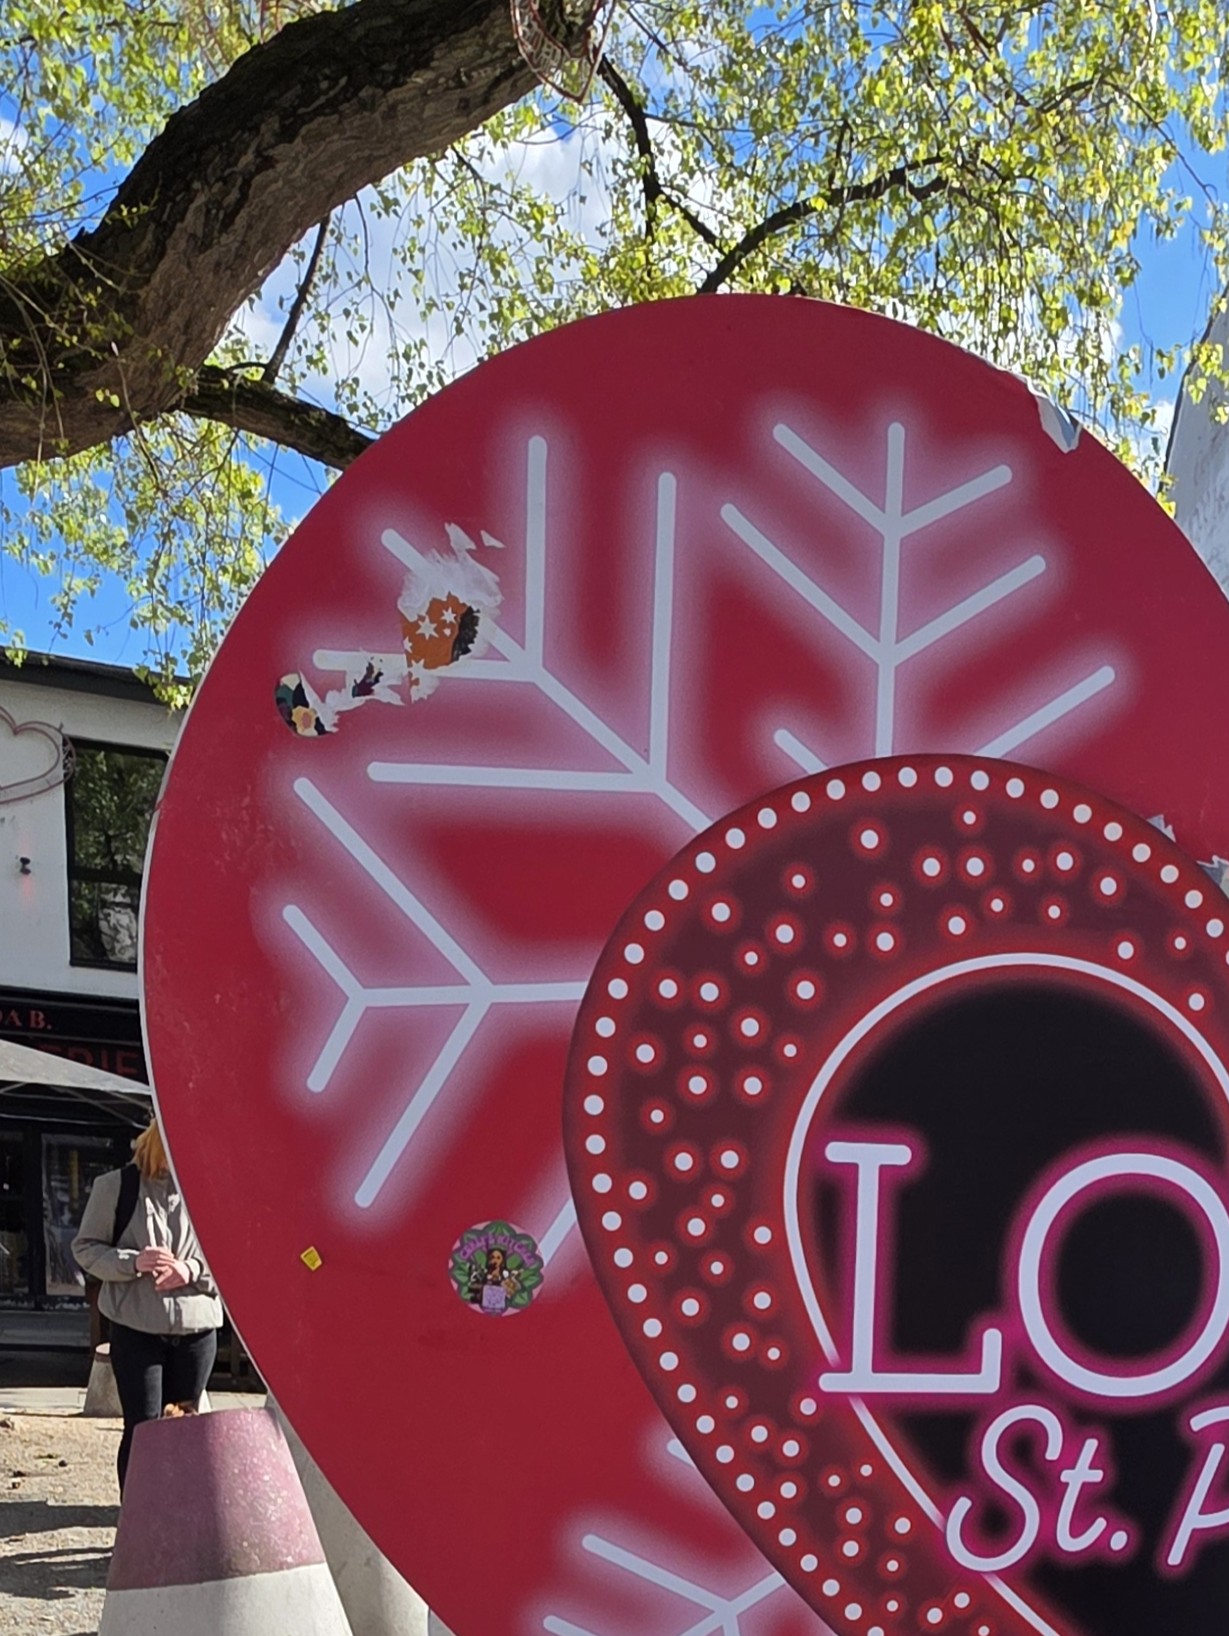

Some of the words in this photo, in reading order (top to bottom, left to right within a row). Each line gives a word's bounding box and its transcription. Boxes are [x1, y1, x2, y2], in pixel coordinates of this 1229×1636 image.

[0, 1008, 22, 1029] A
[29, 1009, 53, 1030] B.
[946, 1403, 1130, 1572] St.
